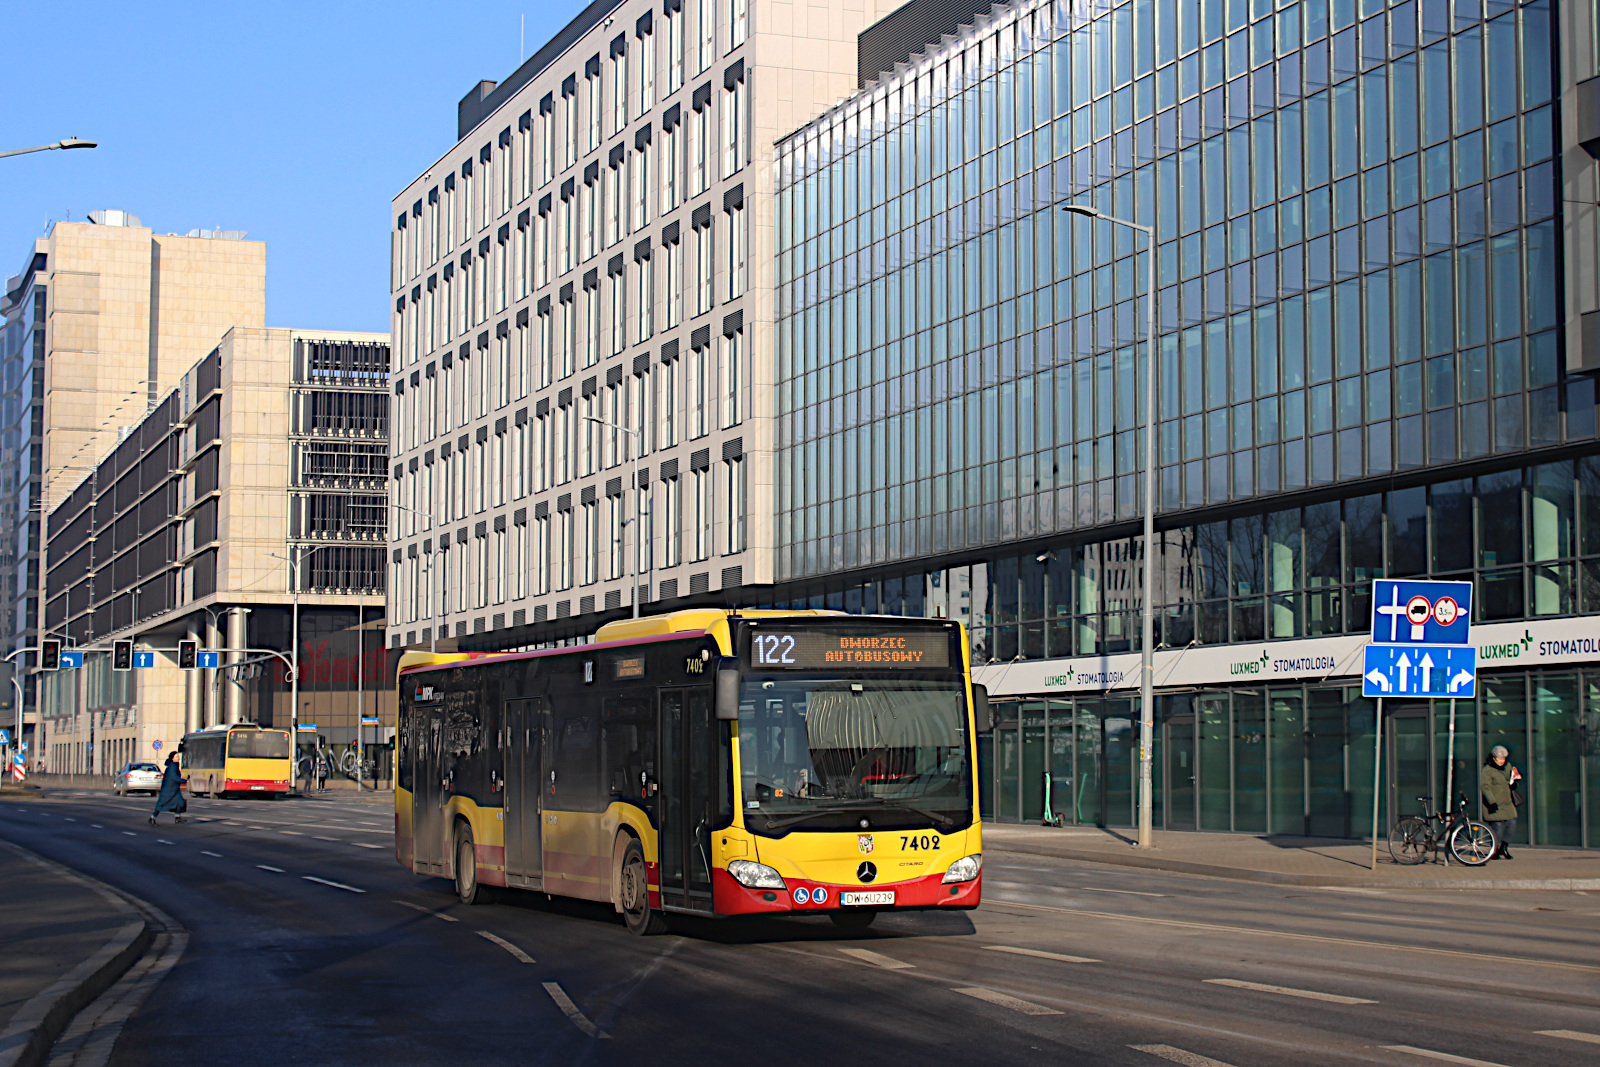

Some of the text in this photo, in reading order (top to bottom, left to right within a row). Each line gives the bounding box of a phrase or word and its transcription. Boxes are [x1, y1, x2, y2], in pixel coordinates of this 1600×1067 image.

[753, 635, 796, 664] 122
[840, 637, 906, 649] DWORZEC
[1480, 638, 1600, 660] LUXMED STOMATOL
[825, 650, 923, 662] AUTOBUSOWY
[1230, 656, 1335, 675] LUXMED STOMATOLOGIA
[1044, 671, 1124, 687] LUXMED STOMATOLOGIA
[900, 835, 940, 851] 7402
[863, 892, 893, 904] 6U239
